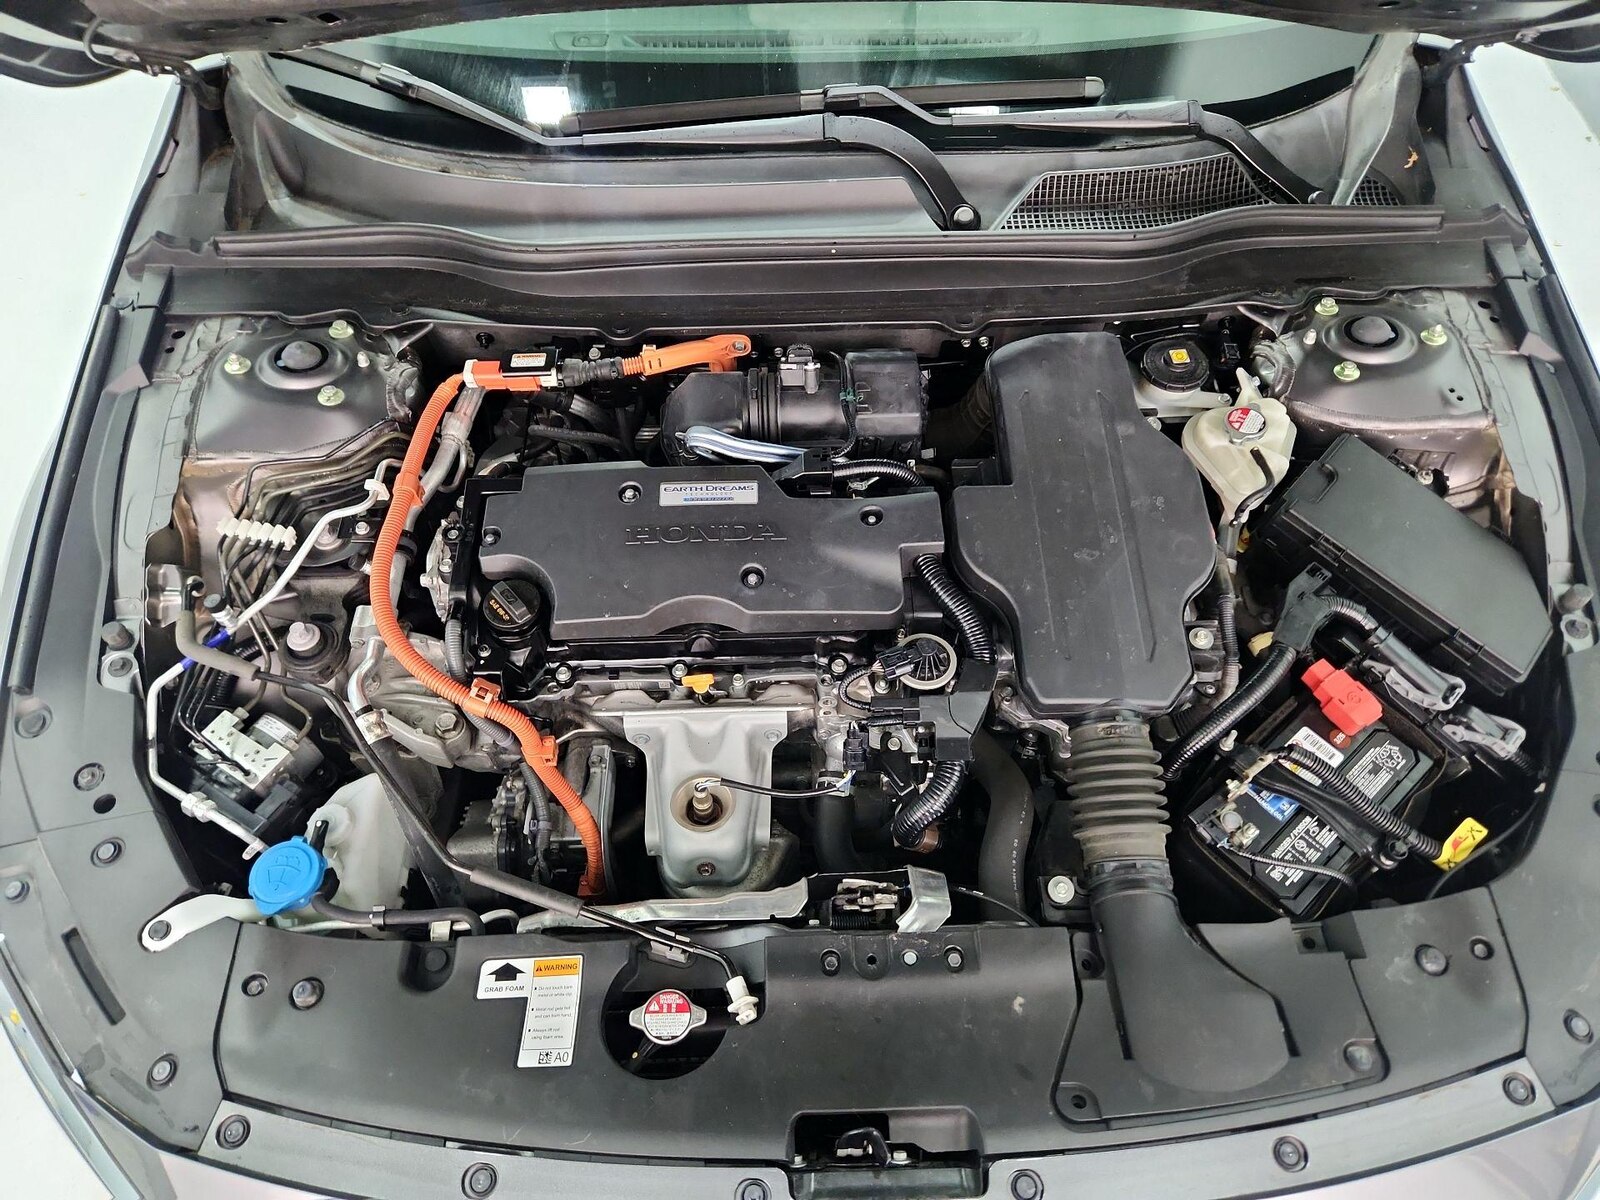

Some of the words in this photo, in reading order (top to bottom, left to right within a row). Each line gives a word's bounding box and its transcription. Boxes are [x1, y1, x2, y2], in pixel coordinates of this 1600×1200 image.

[625, 525, 788, 545] HONDA
[543, 963, 578, 971] WARNING
[554, 1052, 569, 1062] A0
